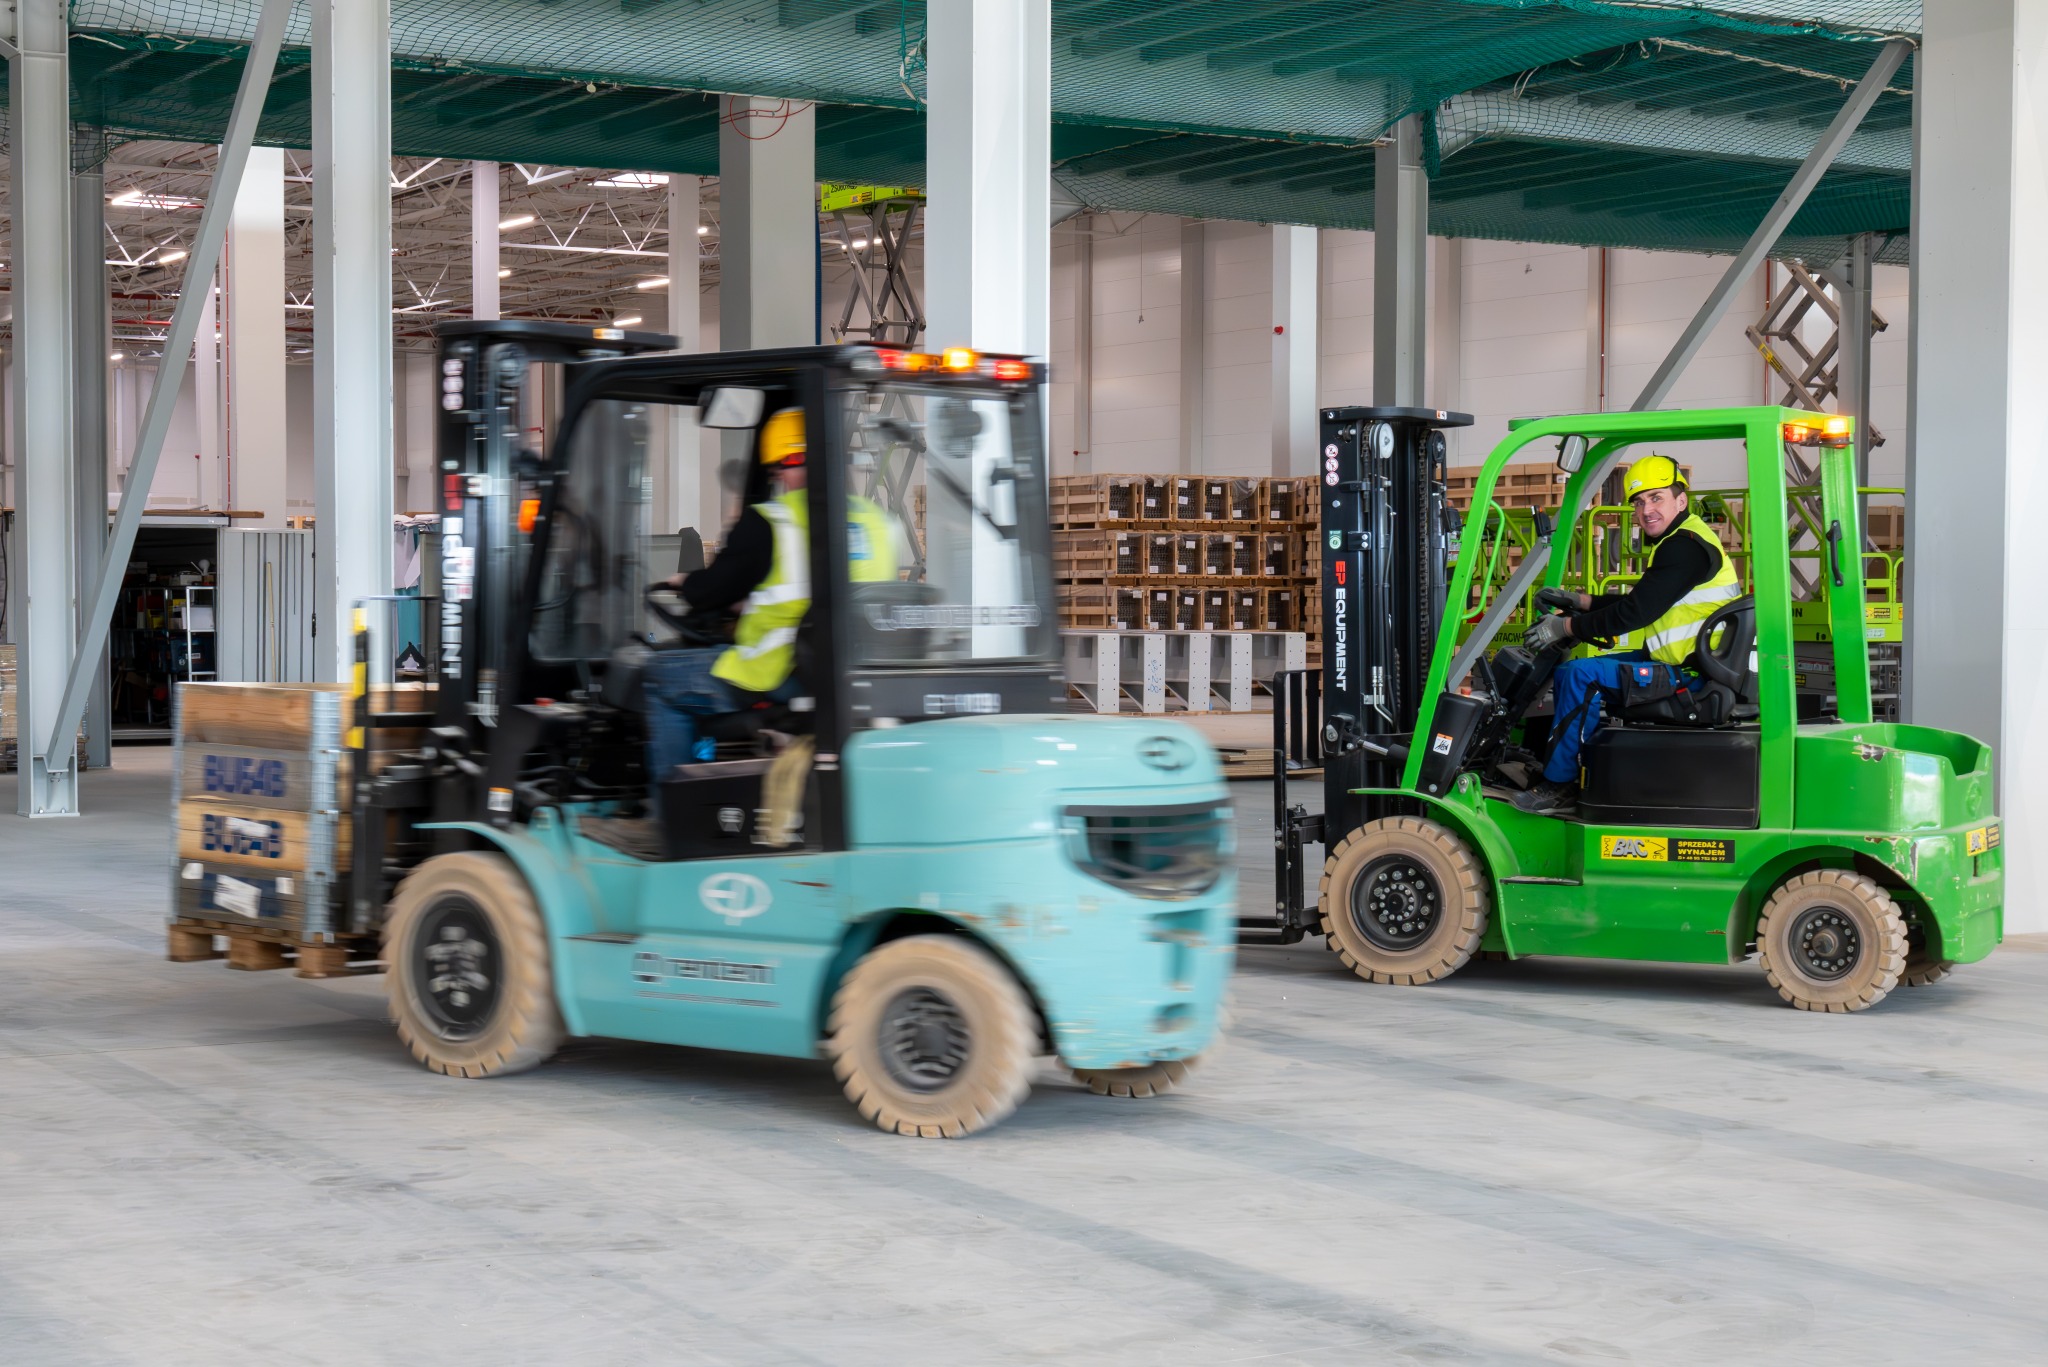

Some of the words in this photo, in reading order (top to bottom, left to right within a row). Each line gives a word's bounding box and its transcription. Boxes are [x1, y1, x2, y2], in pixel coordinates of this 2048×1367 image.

[1335, 560, 1346, 586] EP
[1335, 587, 1347, 692] EQUIPMENT
[1611, 838, 1648, 859] BAC
[1677, 840, 1717, 849] SPRZEDAŻ
[1718, 841, 1725, 849] &
[1677, 848, 1726, 856] WYNAJEM
